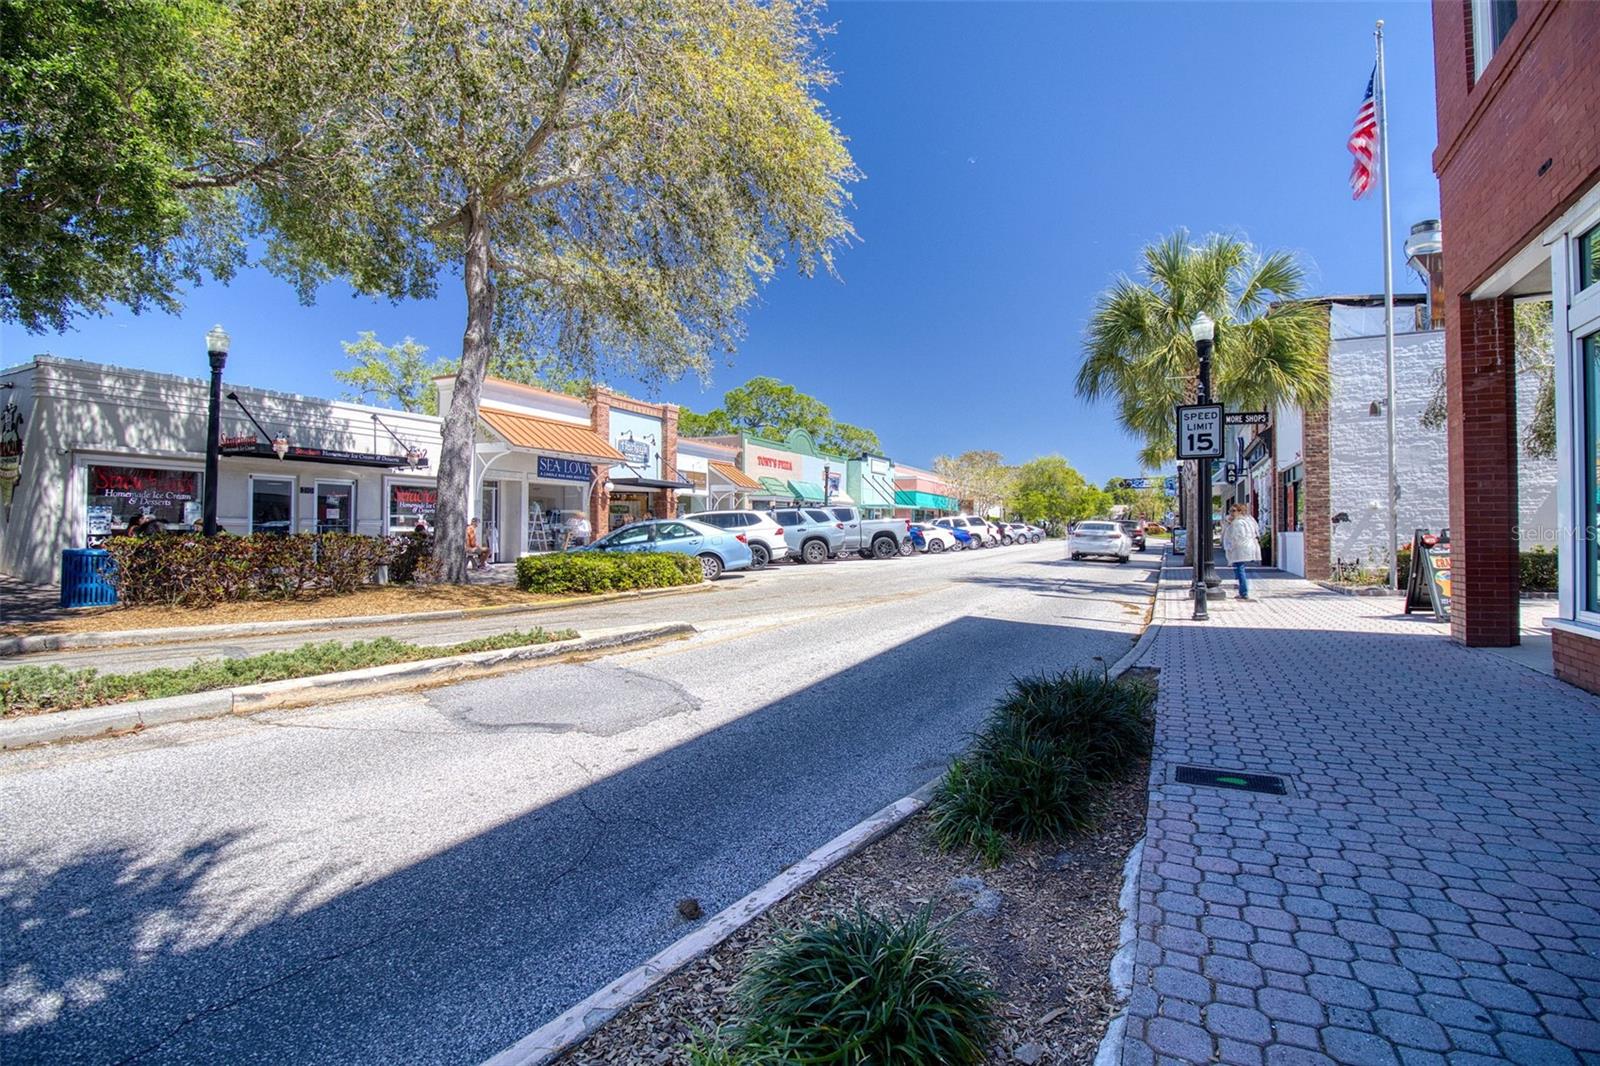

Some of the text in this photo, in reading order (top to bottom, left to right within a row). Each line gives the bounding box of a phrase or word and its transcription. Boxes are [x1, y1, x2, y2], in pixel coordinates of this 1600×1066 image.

[1184, 411, 1218, 421] SPEED
[1225, 414, 1266, 423] MORE SHOPS
[1187, 422, 1214, 431] LIMIT
[1187, 433, 1213, 452] 15
[540, 457, 590, 476] SEA LOVE
[757, 456, 792, 471] TONY'S PIZZA
[1227, 463, 1236, 482] BAR
[104, 488, 192, 501] Homemade Ice Cream
[128, 497, 171, 506] & Desserts
